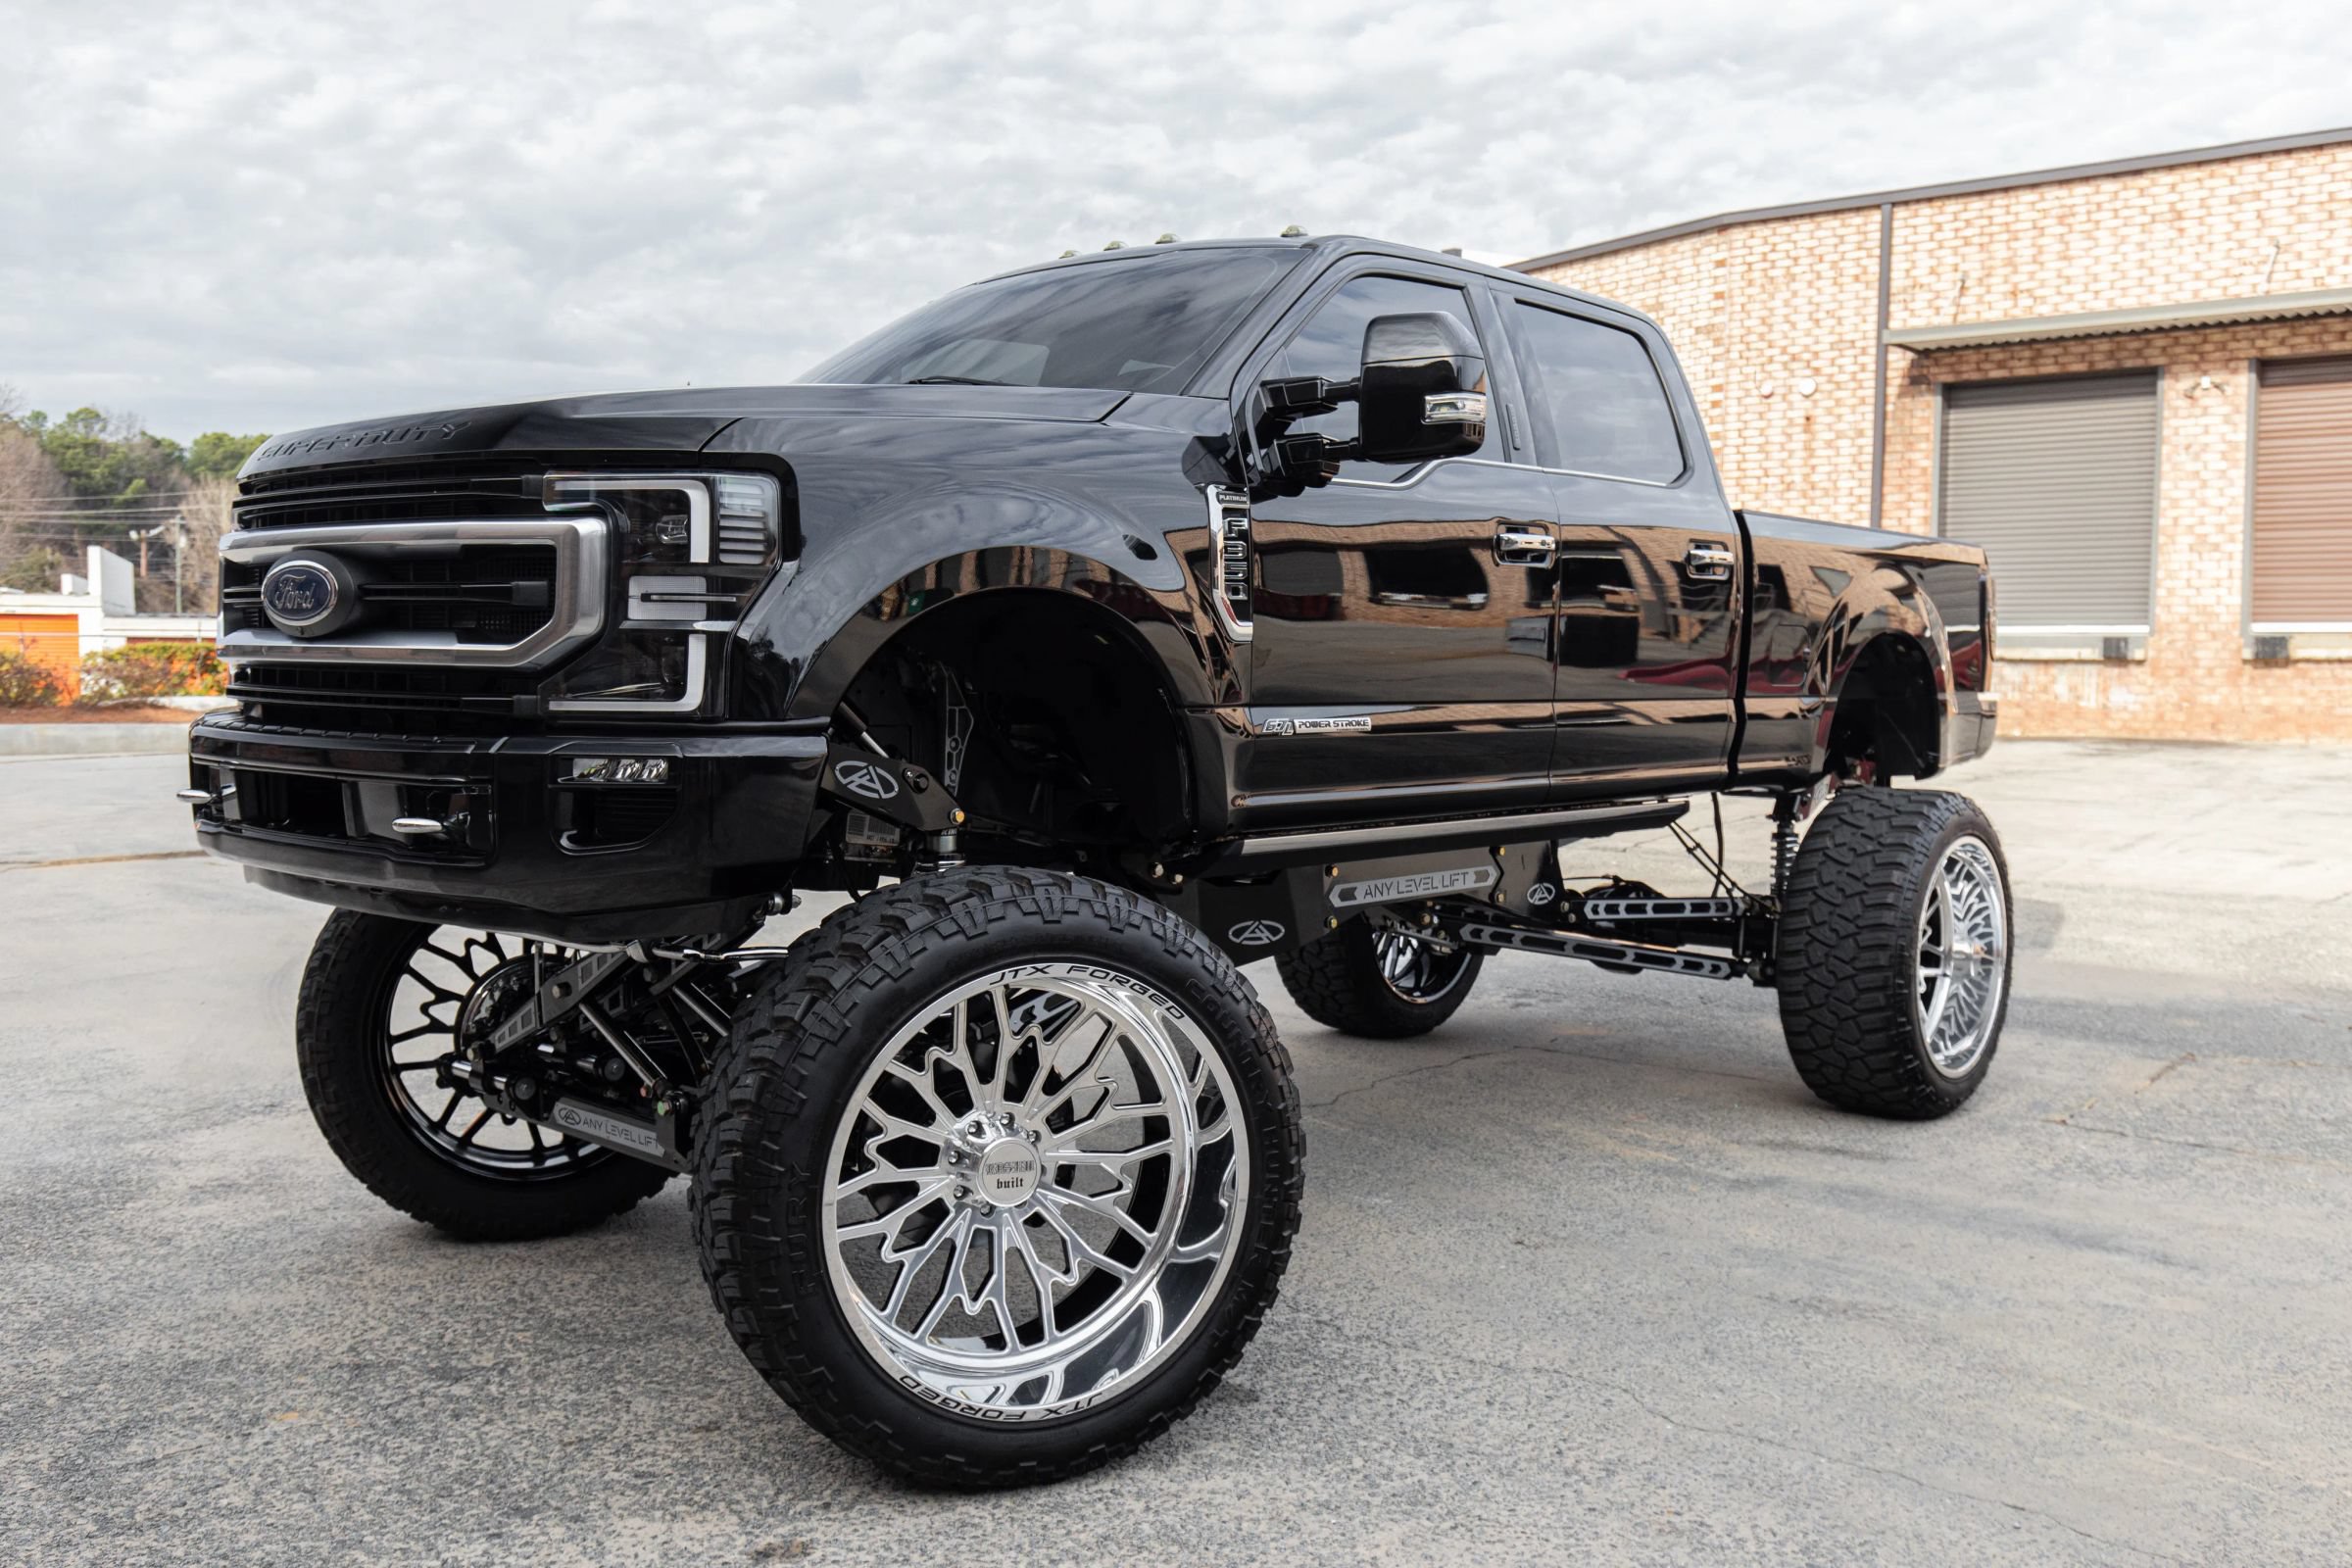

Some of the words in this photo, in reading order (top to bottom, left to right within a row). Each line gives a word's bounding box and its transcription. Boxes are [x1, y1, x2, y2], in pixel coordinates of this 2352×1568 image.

[354, 420, 472, 448] DUTY
[275, 573, 316, 609] Ford
[1298, 719, 1331, 729] POWER
[1332, 718, 1369, 728] STROKE
[1363, 881, 1395, 900] ANY
[1396, 876, 1439, 895] LEVEL
[1442, 871, 1469, 888] LIFT
[989, 964, 1054, 986] JTX
[1066, 964, 1186, 1020] FORGED
[582, 1117, 604, 1130] ANY
[605, 1122, 637, 1144] LEVEL
[638, 1134, 659, 1150] LIFT
[997, 1177, 1023, 1189] built
[899, 1374, 1027, 1422] FORGED
[1040, 1392, 1102, 1420] JTX
